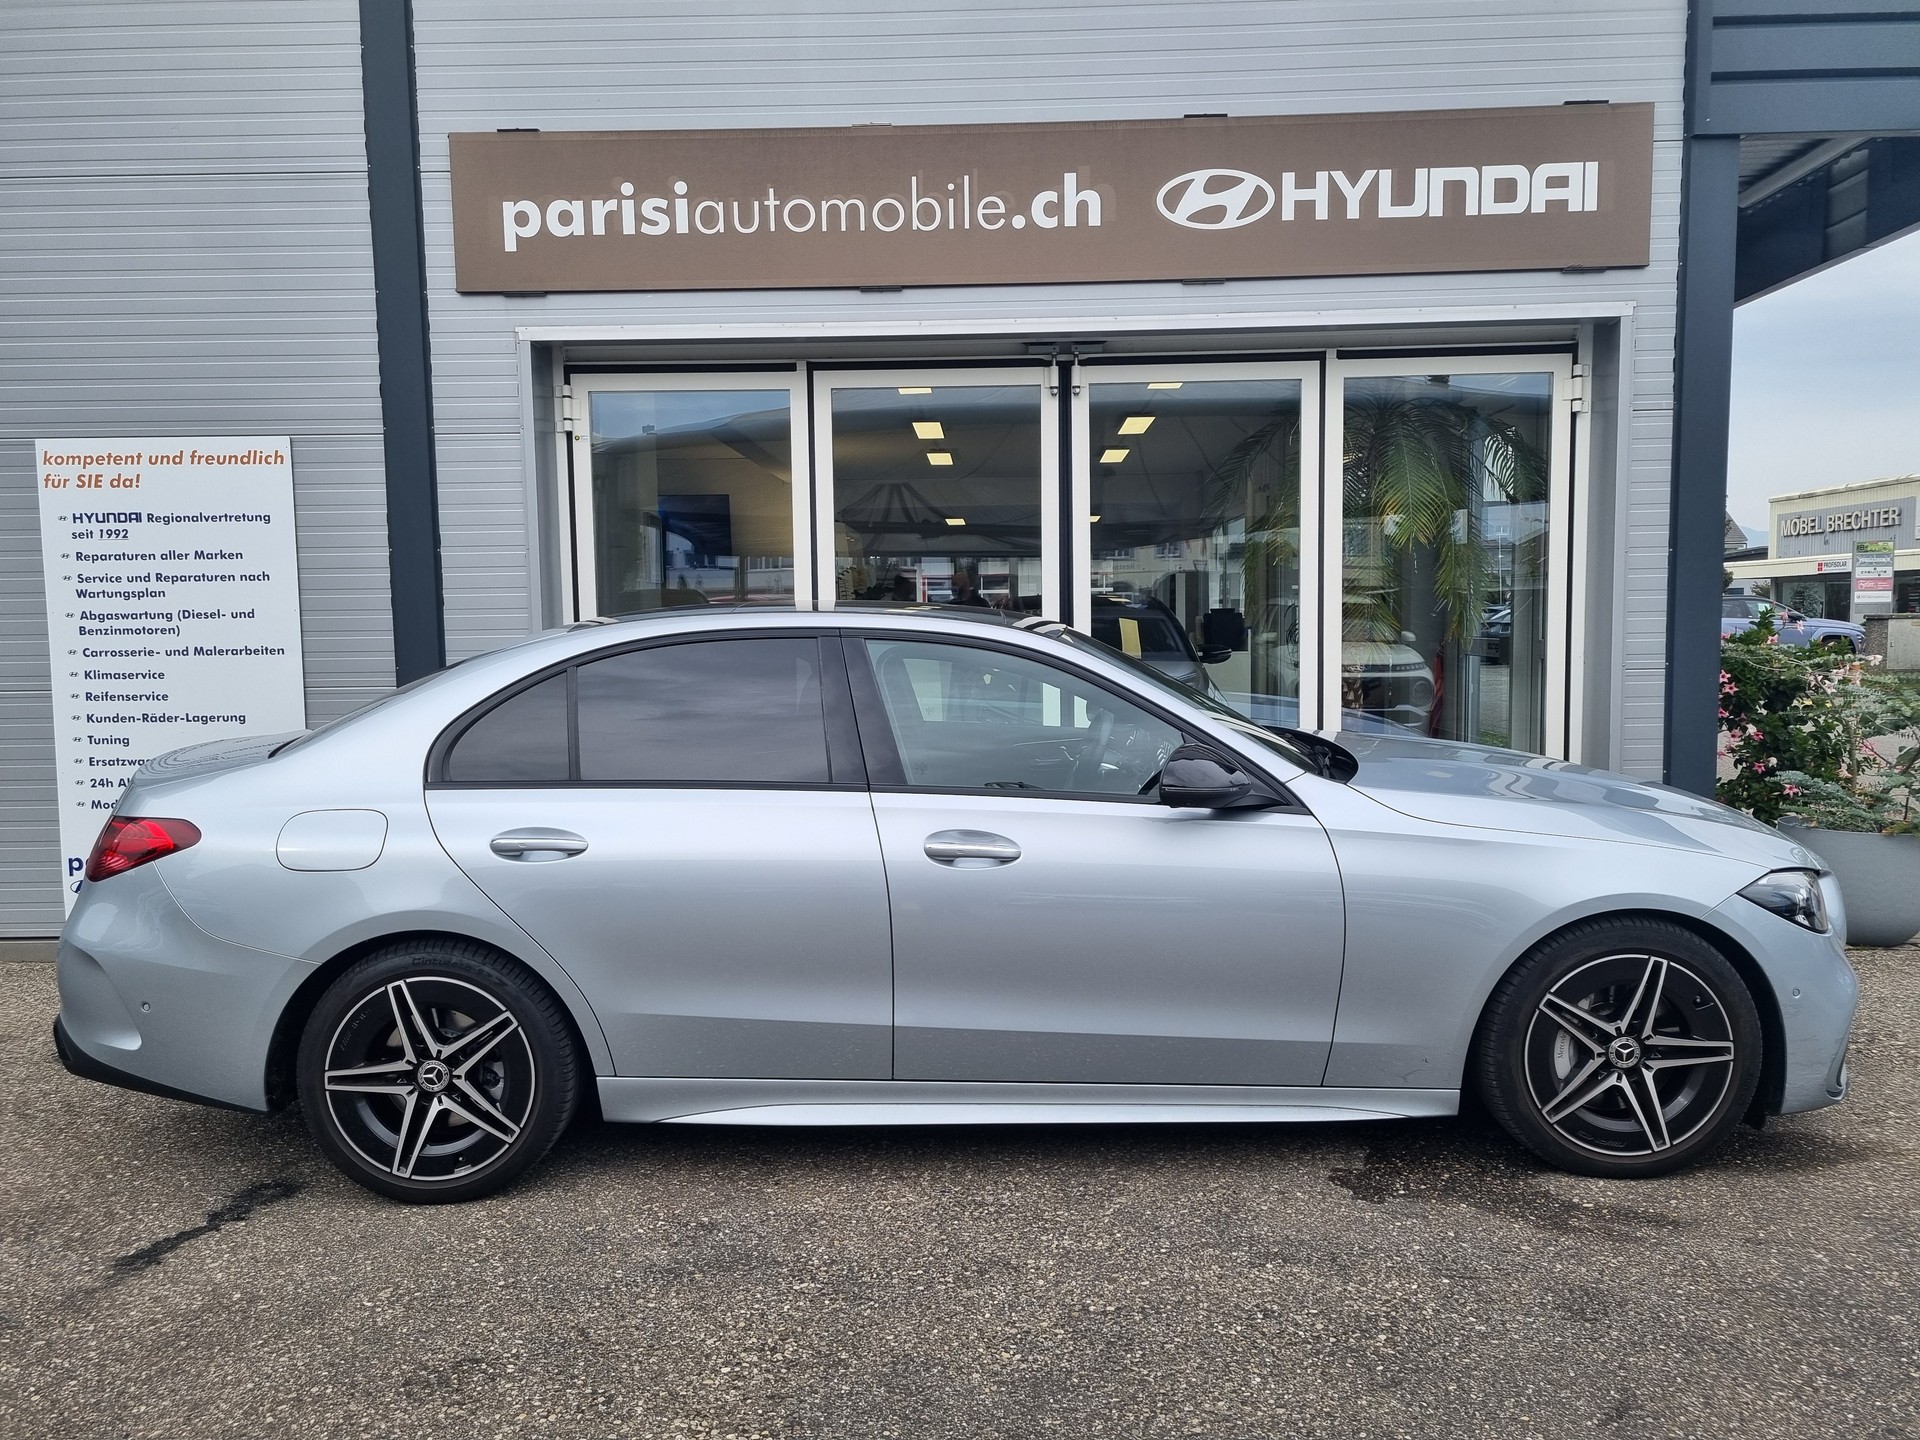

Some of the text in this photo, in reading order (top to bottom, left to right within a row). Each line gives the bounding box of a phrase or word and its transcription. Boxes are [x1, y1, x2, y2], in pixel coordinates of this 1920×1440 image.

[1281, 161, 1599, 221] HYUNDAI
[502, 171, 1102, 252] parisiautomobile.ch
[43, 450, 285, 469] kompetent und freundlich
[43, 473, 141, 488] für SIE da!
[72, 512, 271, 525] HYUNDAI Regionalvertretung
[1781, 507, 1901, 537] MÖBEL BRECHTER
[71, 528, 129, 540] seit 1992
[75, 550, 244, 564] Reparaturen aller Marken
[77, 571, 270, 585] Service und Reparaturen nach
[75, 588, 166, 600] Wartungsplan
[79, 609, 255, 623] Abgaswartung (Diesel- und
[78, 624, 181, 637] Benzinmotoren)
[82, 645, 285, 658] Carrosserie- und Malerarbeiten
[84, 669, 165, 680] Klimaservice
[85, 690, 169, 702] Reifenservice
[86, 711, 246, 725] Kunden-Räder-Lagerung
[87, 735, 130, 748] Tuning
[90, 778, 114, 788] 24h
